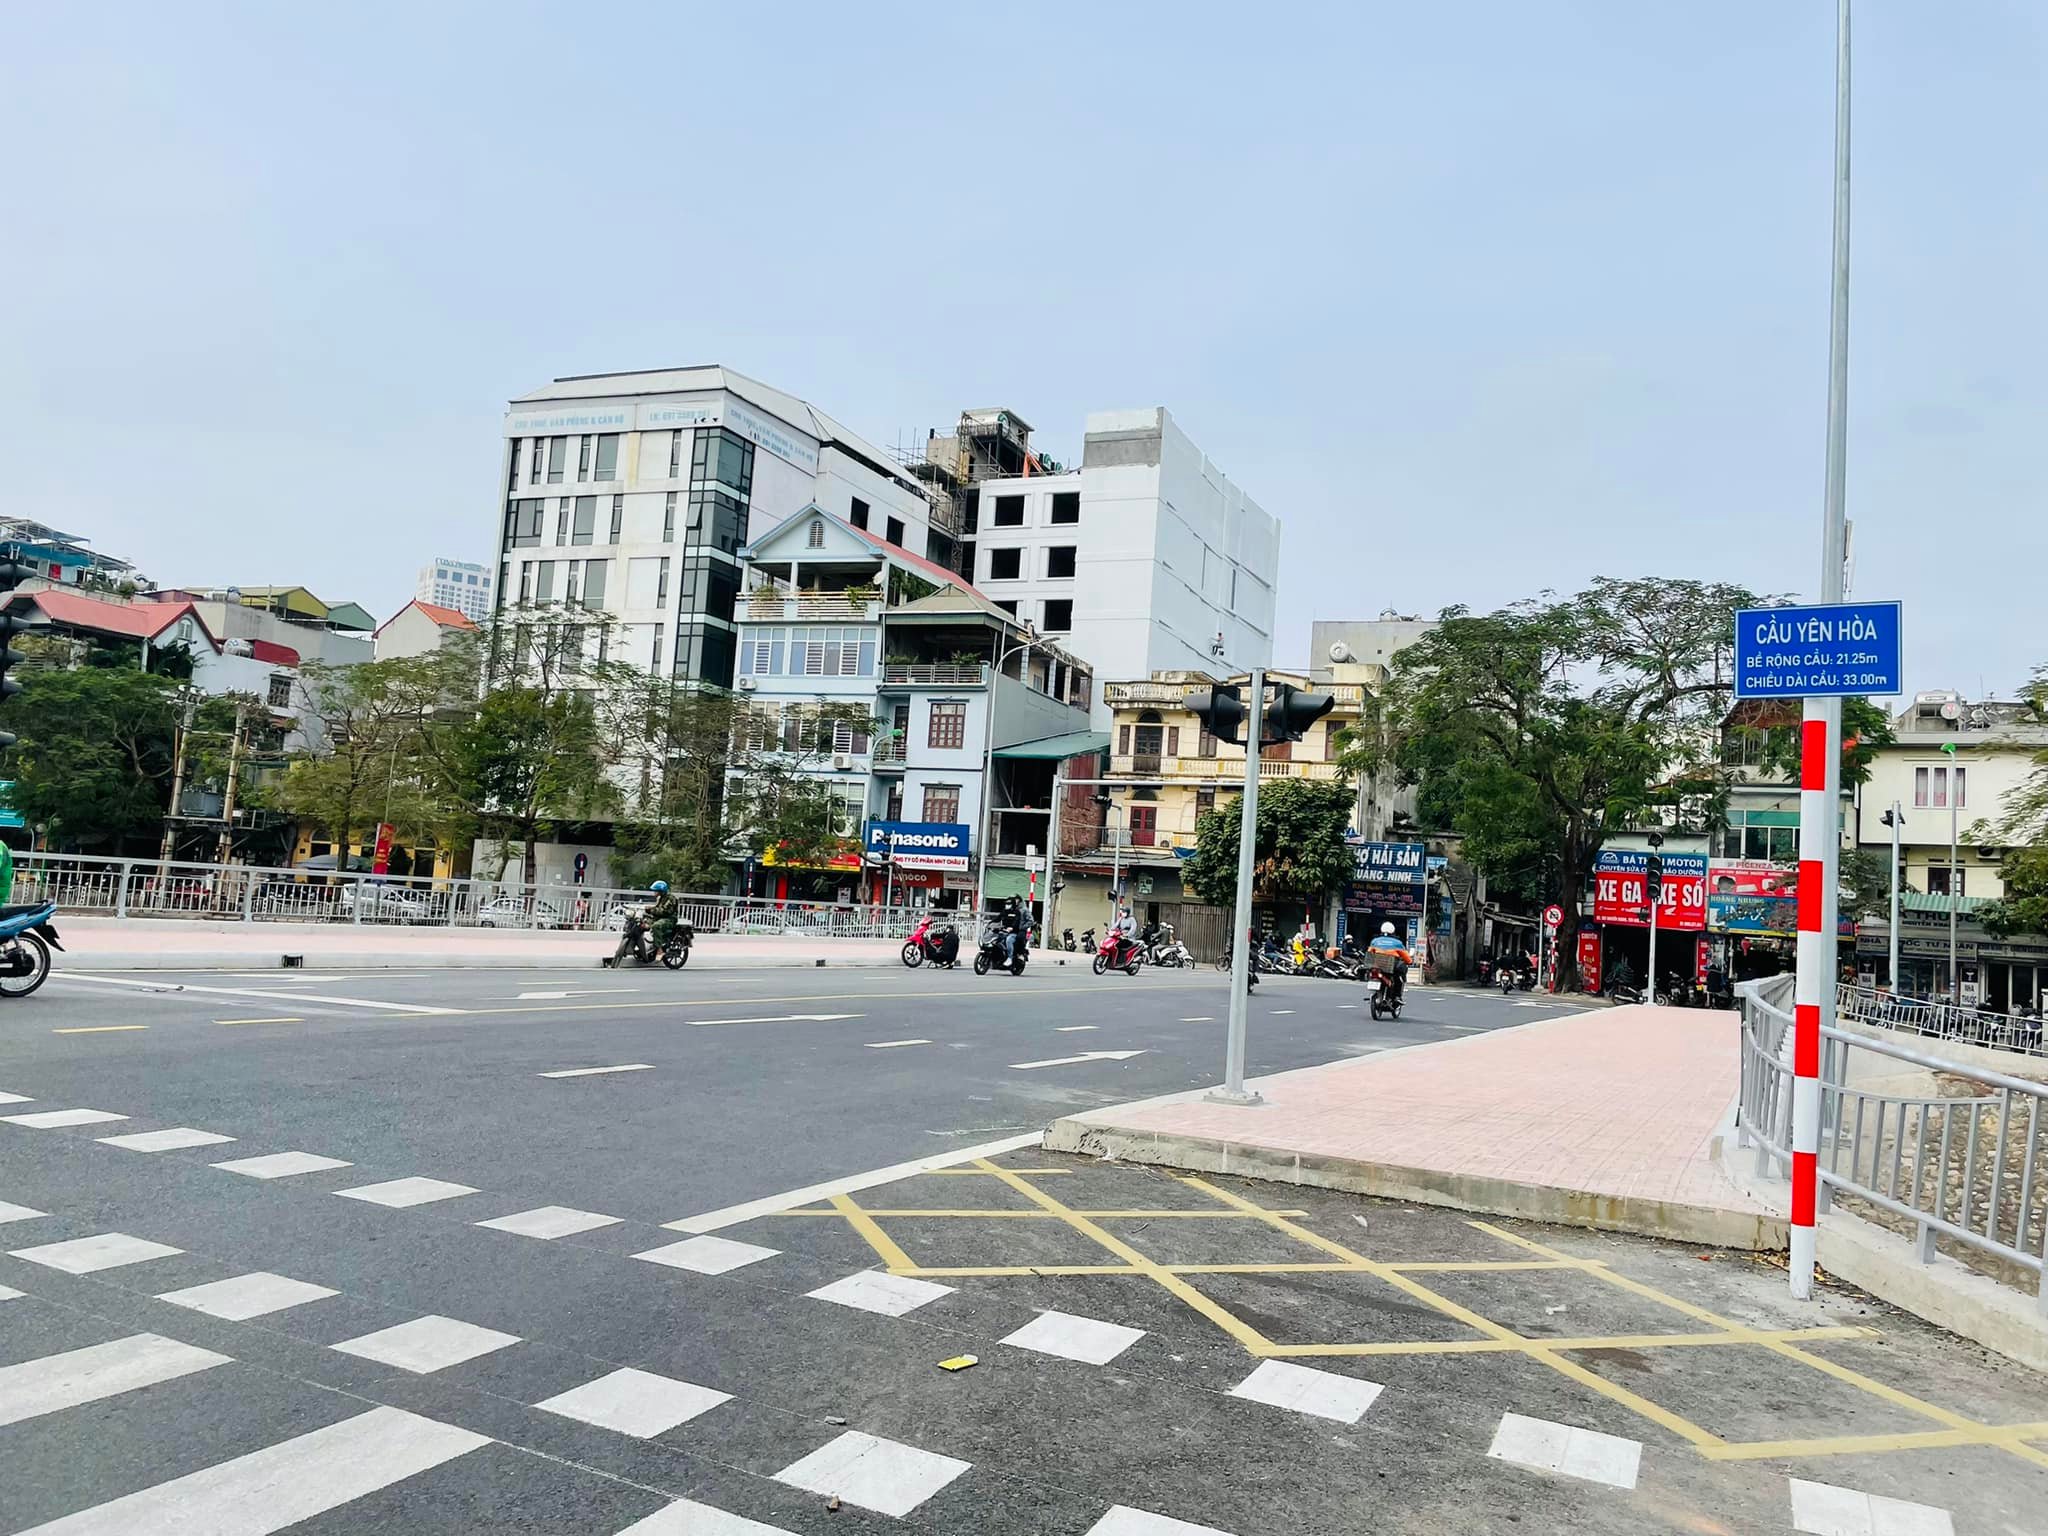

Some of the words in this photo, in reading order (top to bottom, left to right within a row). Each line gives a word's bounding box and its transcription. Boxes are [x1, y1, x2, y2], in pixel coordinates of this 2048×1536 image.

[1756, 615, 1792, 645] CẦU
[1797, 618, 1833, 643] YÊN
[1838, 614, 1878, 641] HÒA
[1746, 651, 1762, 668] BỀ
[1766, 654, 1800, 669] RỘNG
[1804, 649, 1833, 666] CẦU:
[1836, 653, 1878, 666] 21.25m
[1746, 671, 1782, 688] CHIỀU
[1786, 672, 1806, 688] DÀI
[1810, 670, 1840, 686] CẦU:
[1843, 674, 1886, 686] 33.00m
[872, 829, 958, 848] Pnasonic
[1372, 844, 1392, 864] HẢI
[1396, 846, 1420, 866] SẢN
[1667, 858, 1703, 868] MOTOR
[1354, 866, 1384, 880] UẢNG
[1388, 871, 1412, 882] NINH
[1598, 880, 1617, 902] XE
[1622, 880, 1642, 903] GA
[1658, 883, 1677, 906] XE
[1682, 878, 1704, 908] SỐ
